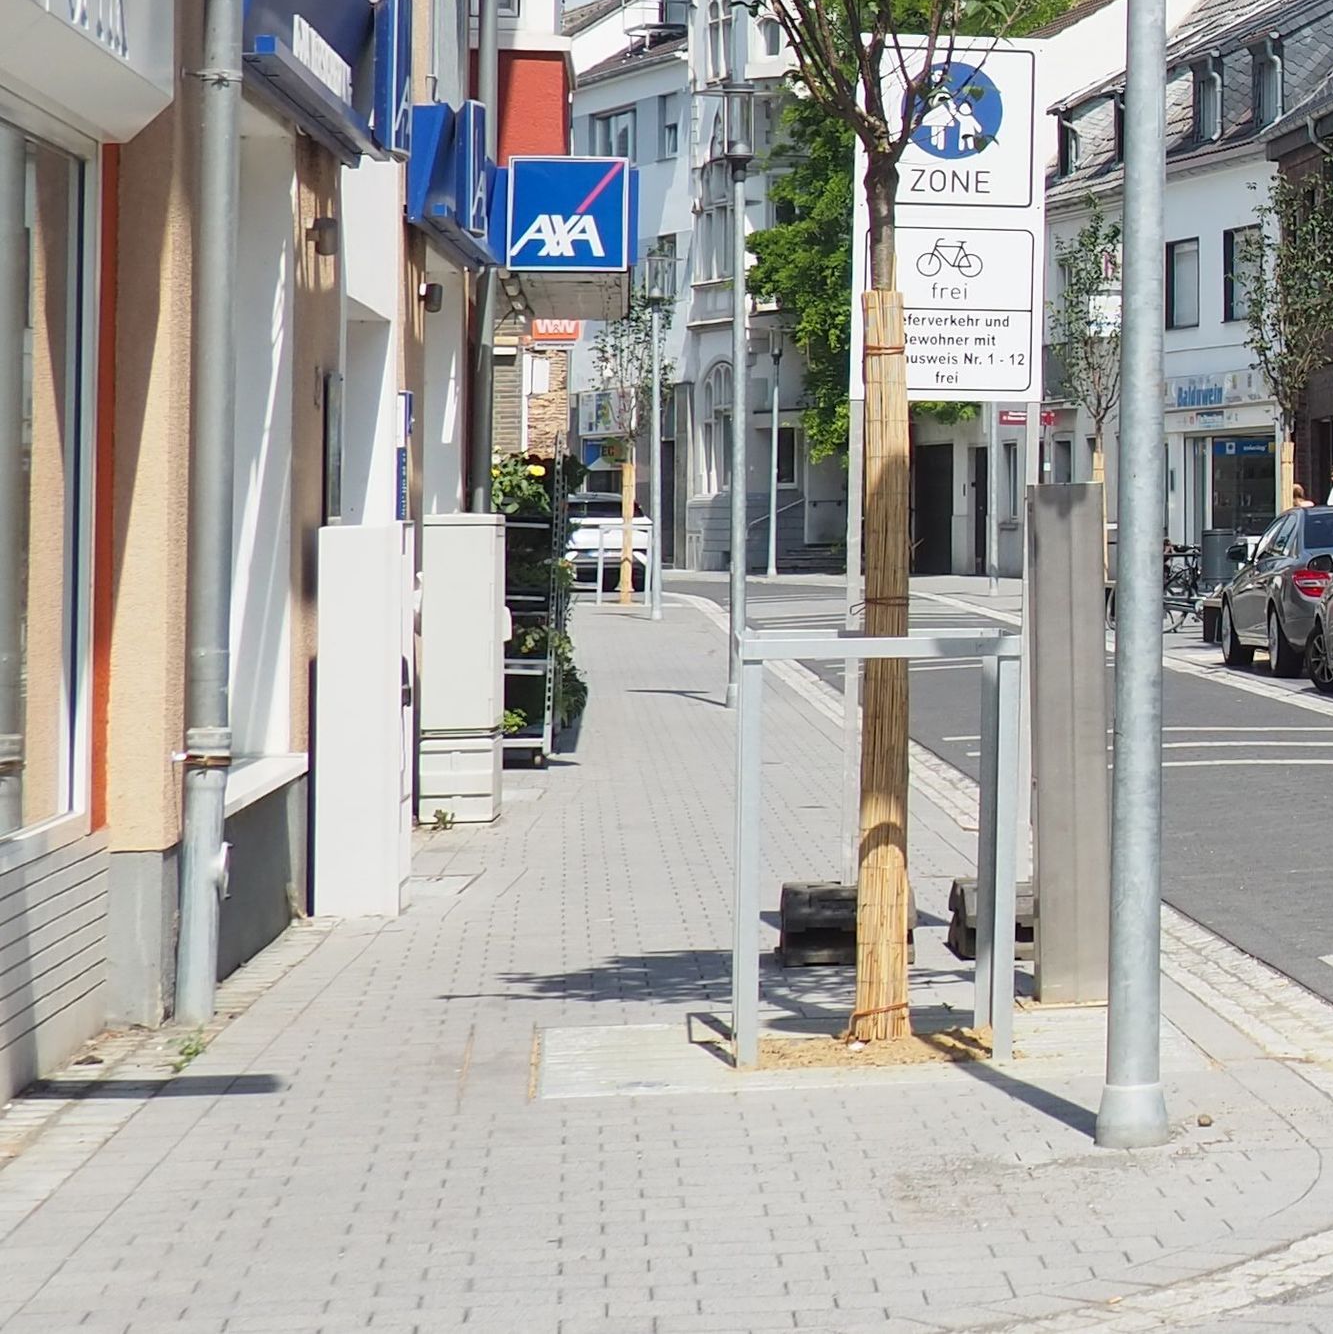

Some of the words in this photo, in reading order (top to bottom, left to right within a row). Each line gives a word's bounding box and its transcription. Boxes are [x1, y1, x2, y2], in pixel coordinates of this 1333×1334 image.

[910, 169, 991, 194] ZONE
[510, 214, 605, 257] AXA
[932, 282, 967, 300] frei
[985, 315, 1010, 328] und
[974, 334, 996, 346] mit
[963, 353, 983, 366] Nr.
[987, 353, 995, 365] 1
[1009, 354, 1026, 366] 12
[935, 371, 959, 383] frei
